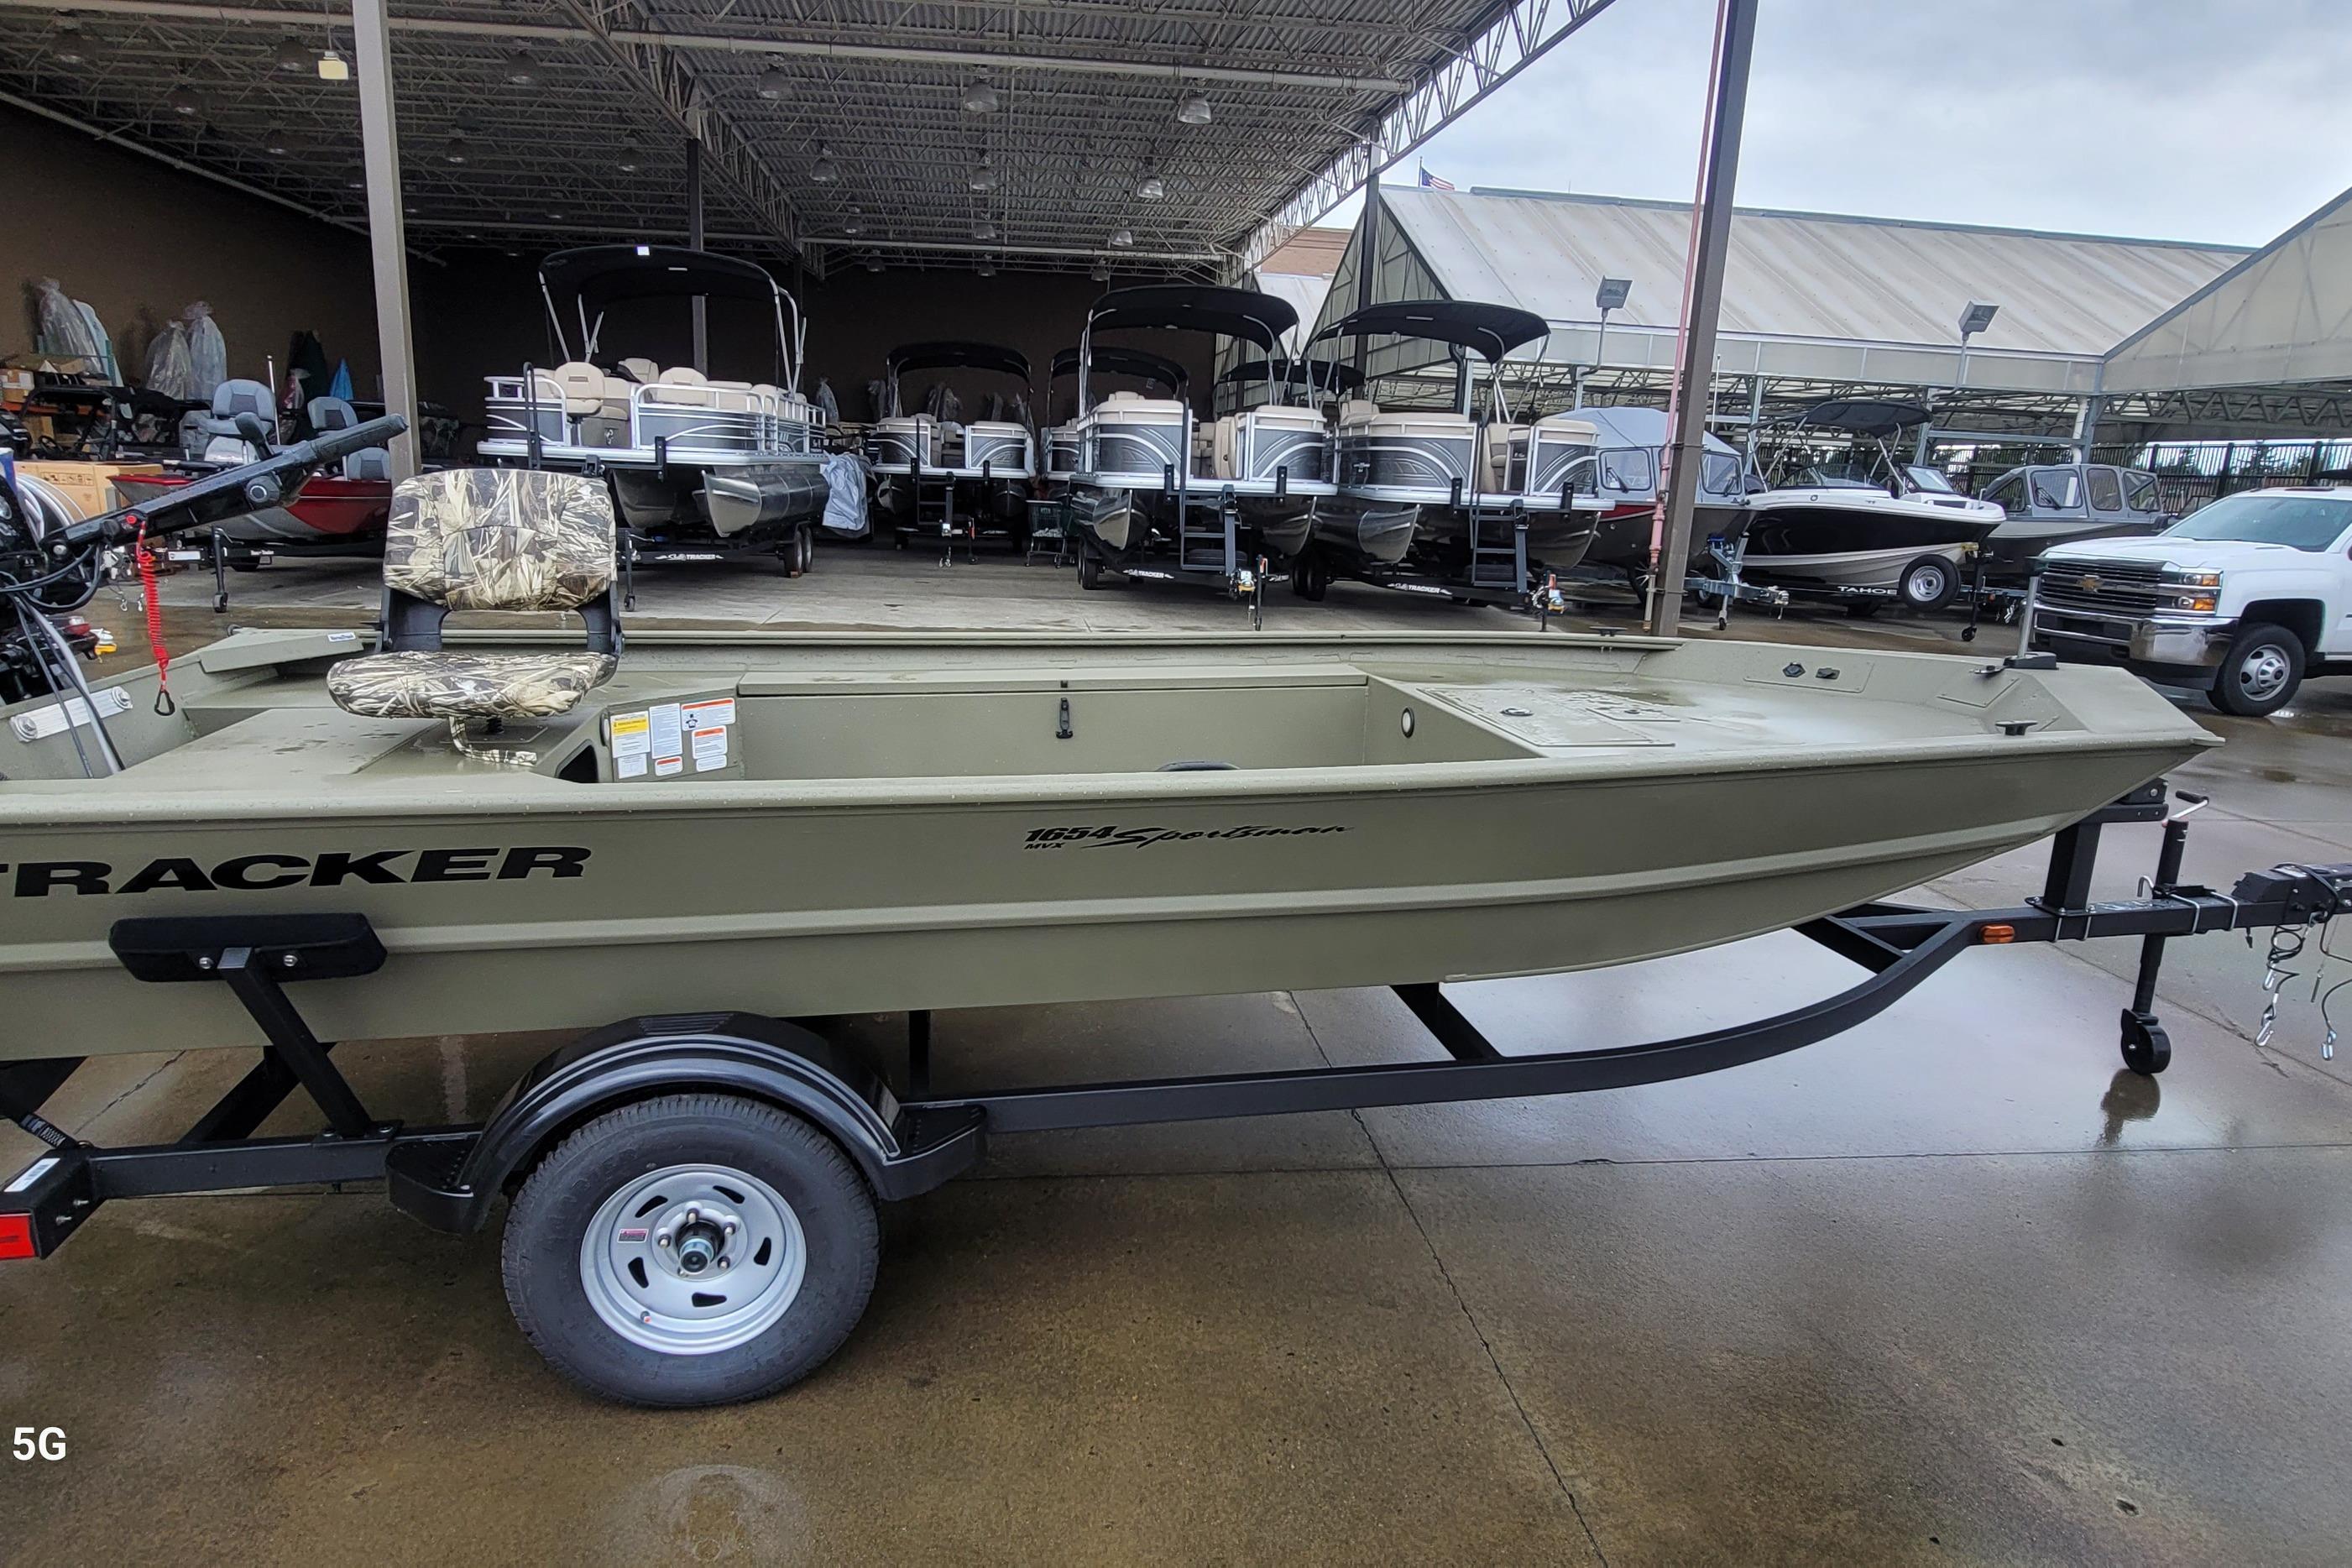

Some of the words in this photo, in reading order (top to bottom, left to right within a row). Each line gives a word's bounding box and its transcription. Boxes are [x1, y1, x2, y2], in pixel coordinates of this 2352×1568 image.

[1409, 584, 1440, 593] TRACKER
[1837, 586, 1897, 595] TAHOE
[1025, 825, 1118, 843] 1654
[1080, 825, 1354, 849] Sportsman
[0, 846, 592, 897] RACKER
